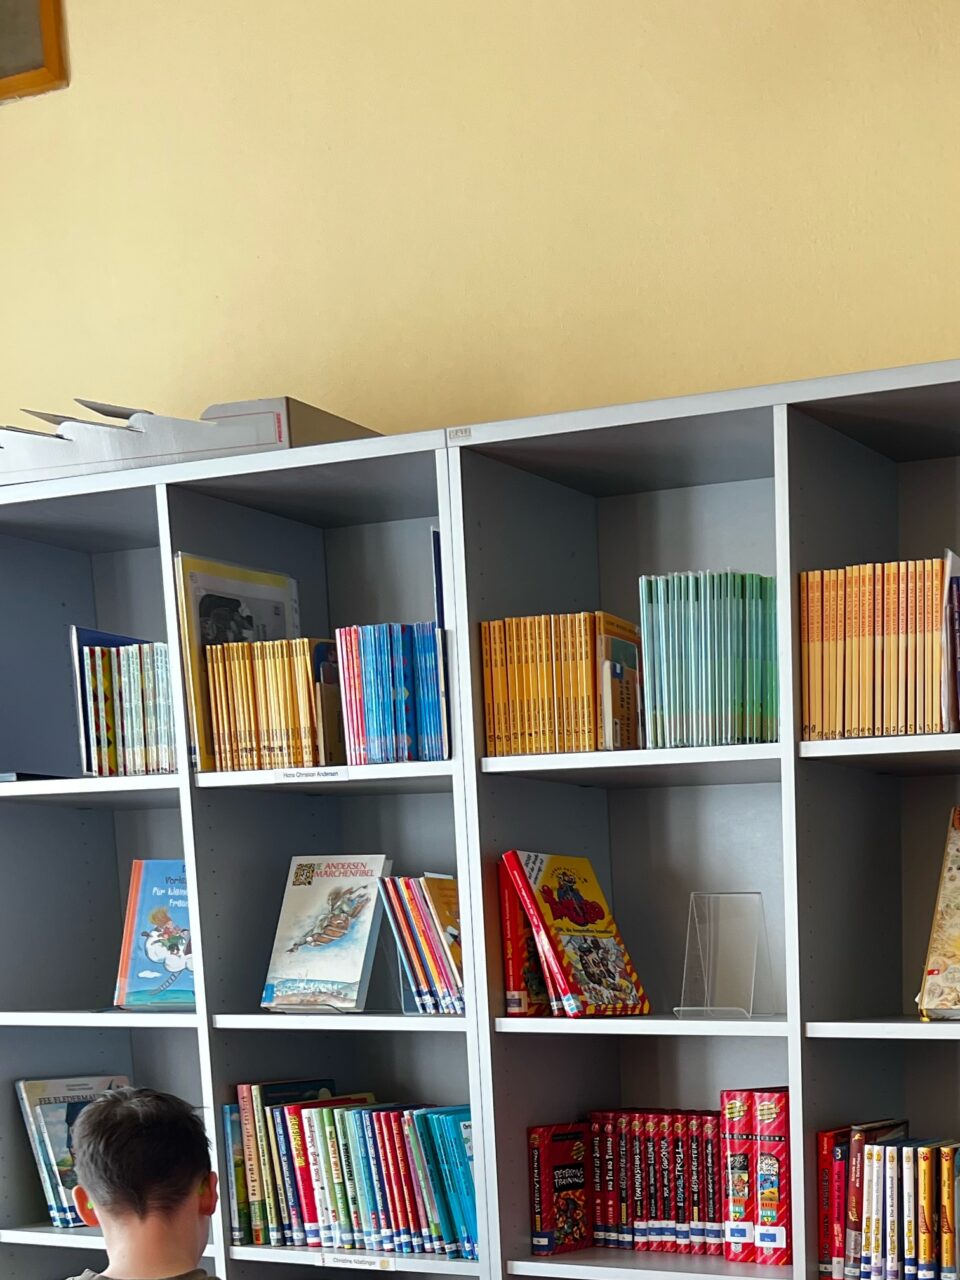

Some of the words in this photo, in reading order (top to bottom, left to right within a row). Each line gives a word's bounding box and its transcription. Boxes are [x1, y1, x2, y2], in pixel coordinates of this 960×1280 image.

[324, 862, 367, 870] ANDERSEN
[53, 1094, 96, 1103] FLEDERMAU
[248, 1164, 257, 1182] große
[554, 1174, 585, 1184] TRAINING
